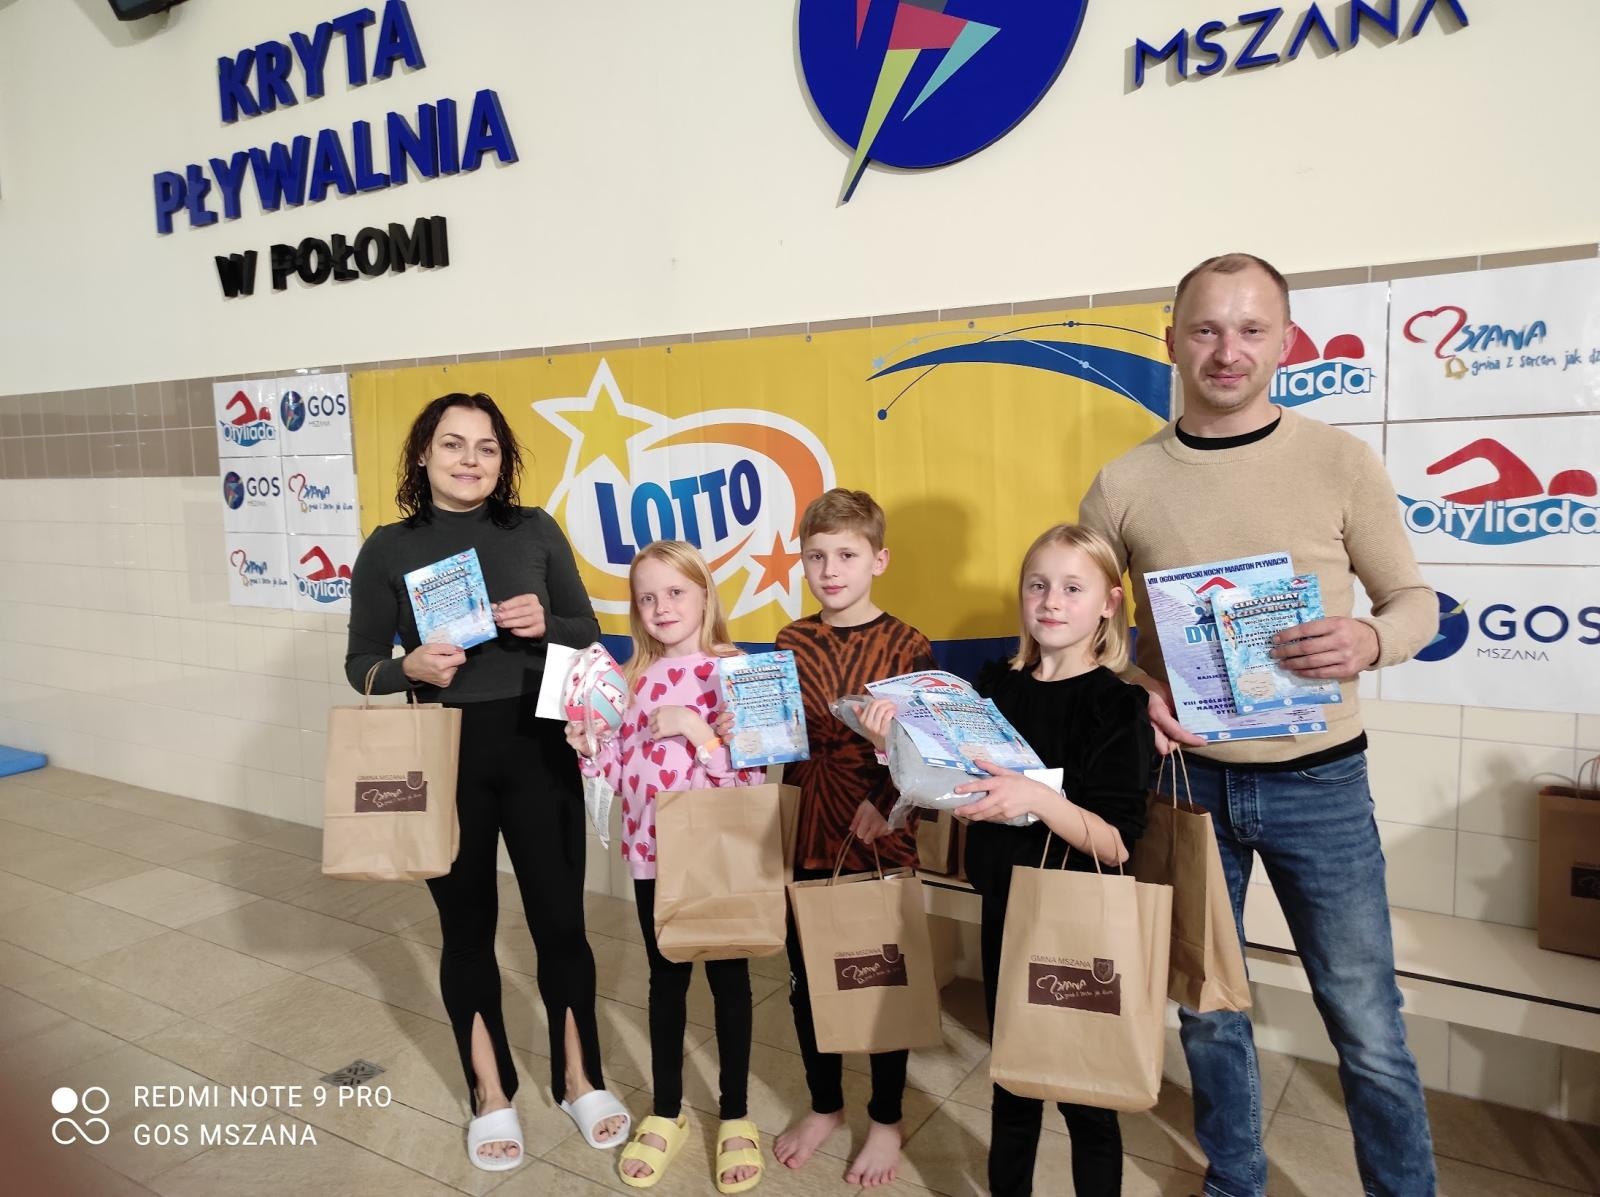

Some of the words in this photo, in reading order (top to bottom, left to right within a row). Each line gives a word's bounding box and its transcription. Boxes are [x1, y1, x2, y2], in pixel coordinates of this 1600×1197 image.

[1135, 0, 1469, 90] MSZANA
[218, 0, 426, 123] KRYTA
[153, 88, 519, 235] PŁYWALNIA
[215, 250, 258, 298] W
[270, 215, 449, 291] POŁOMI
[1562, 348, 1582, 371] jak
[1270, 362, 1371, 397] liada
[307, 394, 346, 417] GOS
[223, 423, 276, 445] Otyliada
[246, 476, 281, 497] GOS
[594, 459, 762, 565] LOTTO
[1405, 499, 1600, 541] Otyliada
[1203, 567, 1224, 577] NOCNY
[1224, 562, 1255, 574] MARATON
[1185, 623, 1220, 643] DY
[1478, 603, 1600, 645] GOS
[1477, 648, 1550, 661] MSZANA
[1199, 697, 1234, 705] OGÓLNOP
